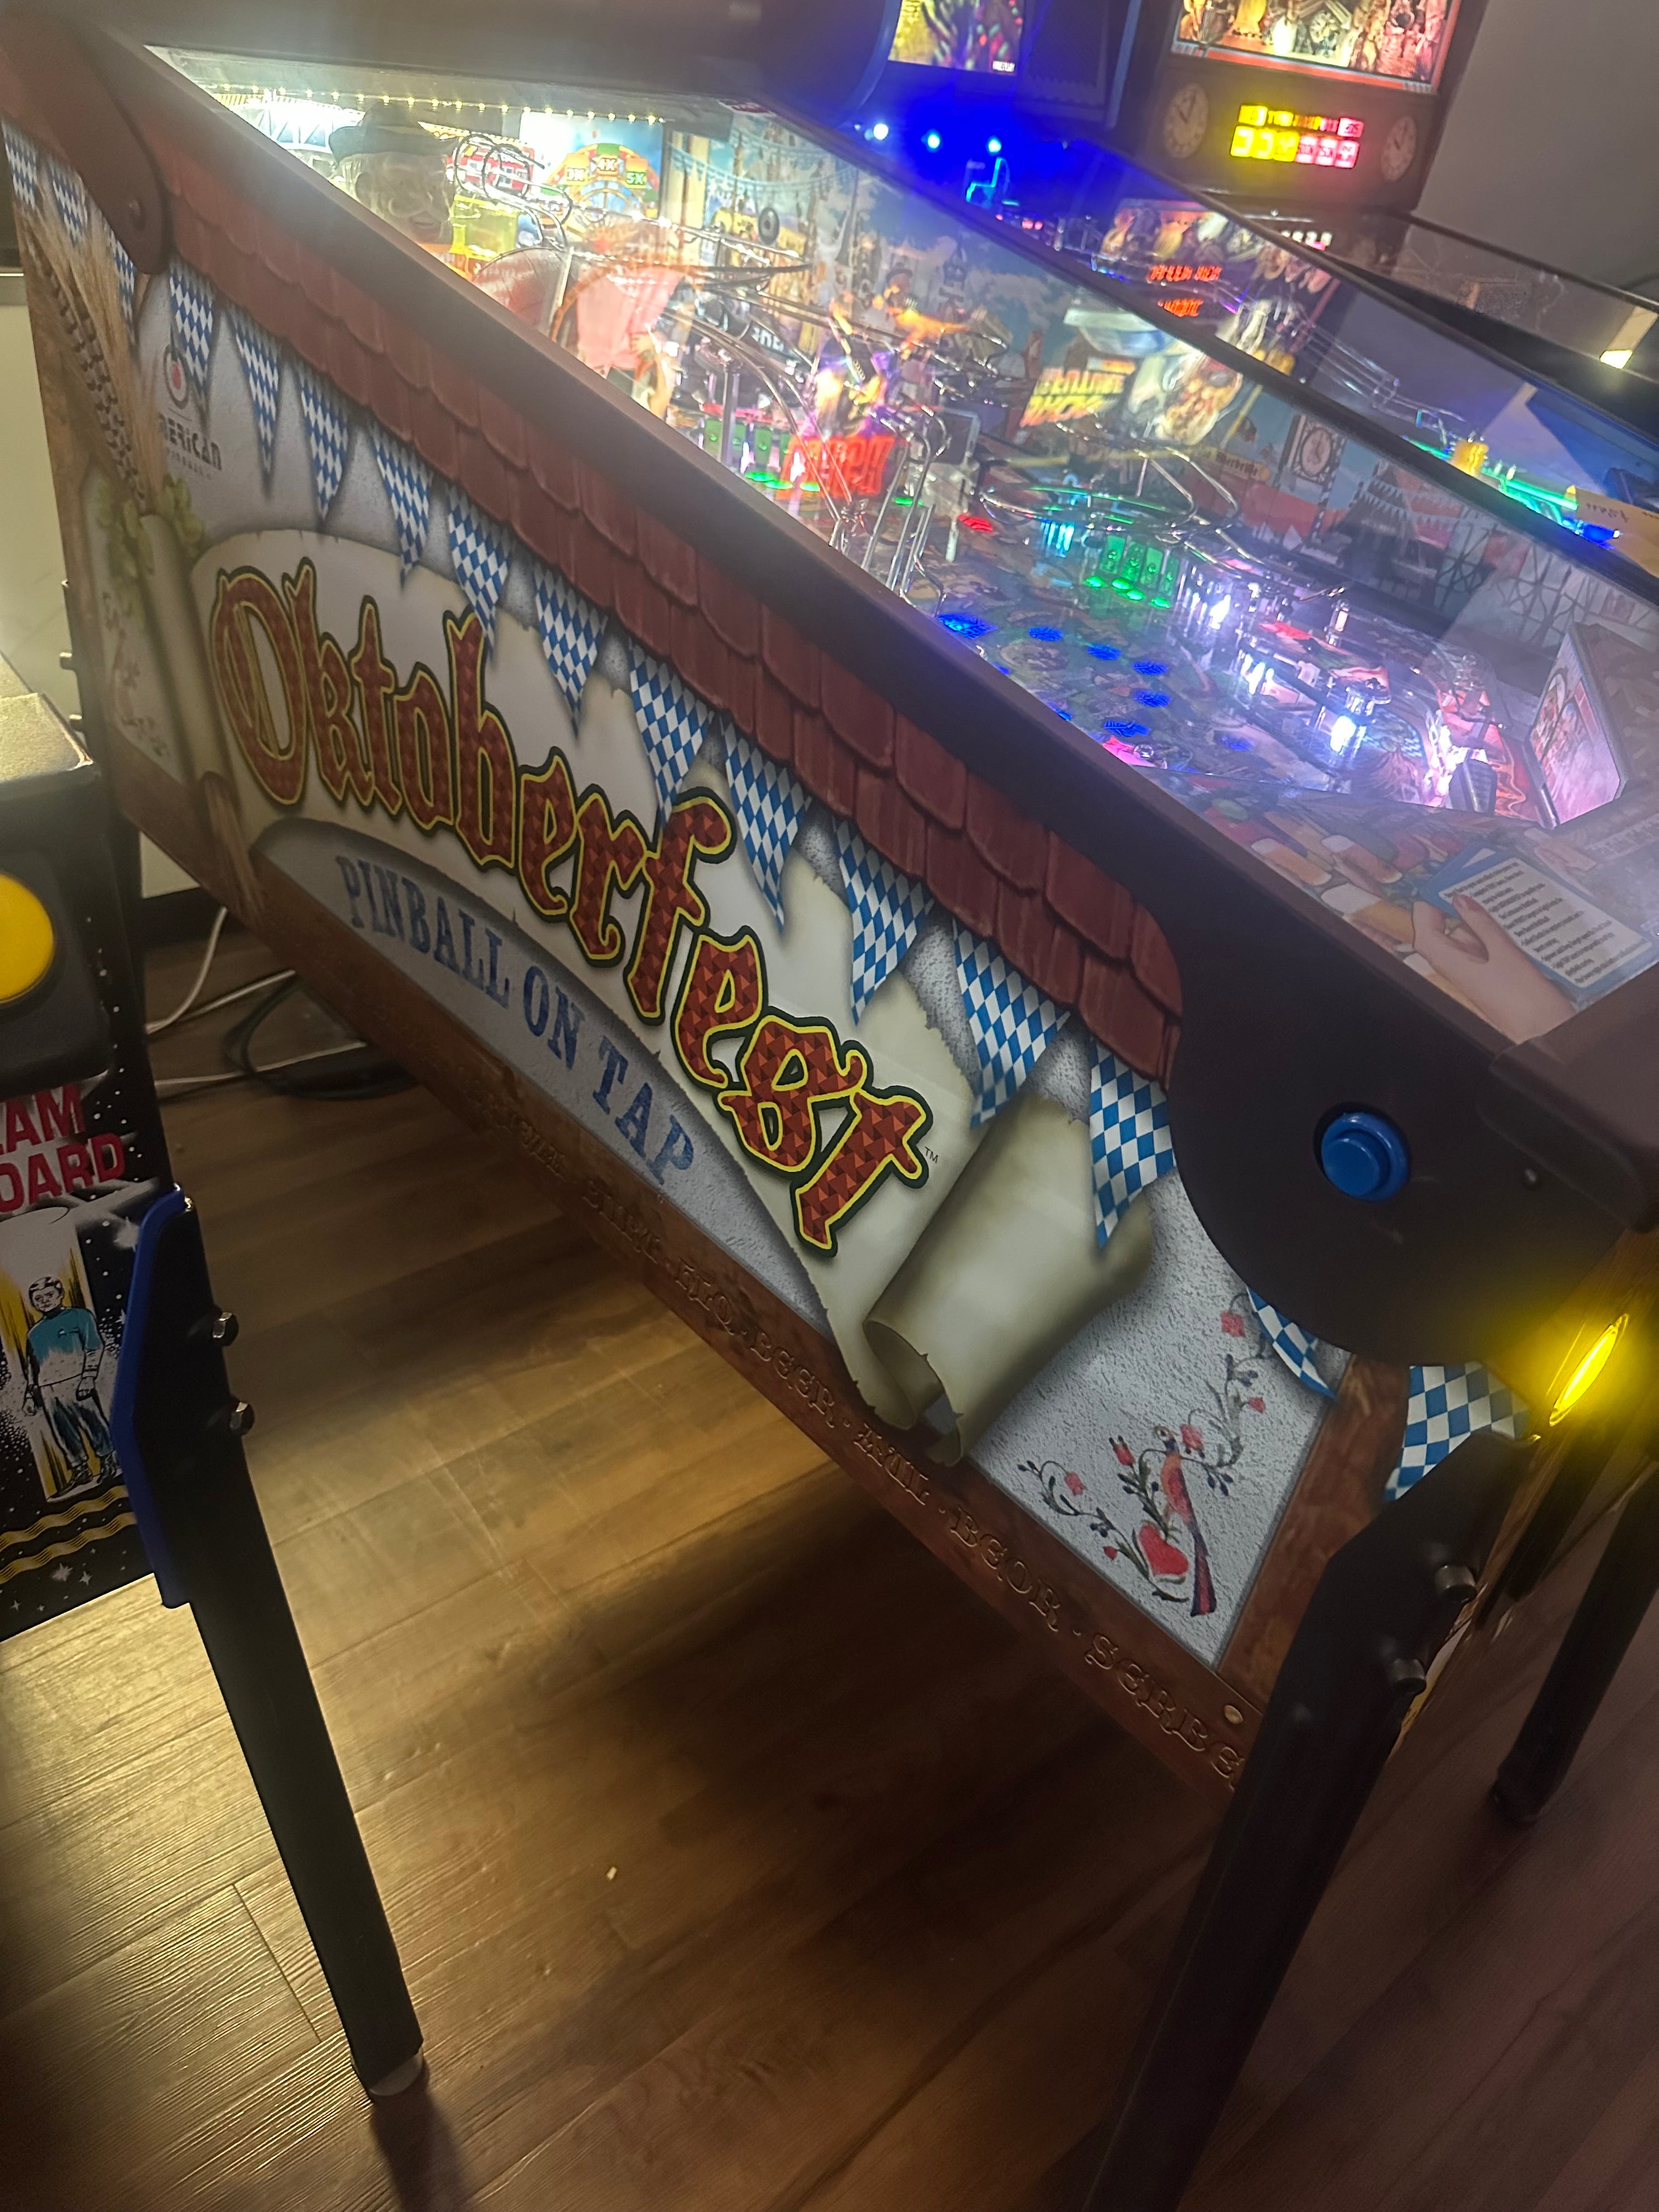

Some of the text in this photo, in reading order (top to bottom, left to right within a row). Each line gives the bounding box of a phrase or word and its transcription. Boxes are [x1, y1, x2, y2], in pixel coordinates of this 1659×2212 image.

[597, 158, 616, 171] 4X
[626, 172, 645, 185] 5X
[209, 557, 934, 1259] Oktoberfest
[336, 854, 509, 1010] PINBALL
[523, 965, 585, 1070] ON
[592, 1036, 694, 1186] TAP
[0, 1082, 85, 1155] AM
[924, 1146, 938, 1164] TM
[1085, 1633, 1245, 1793] SERBE
